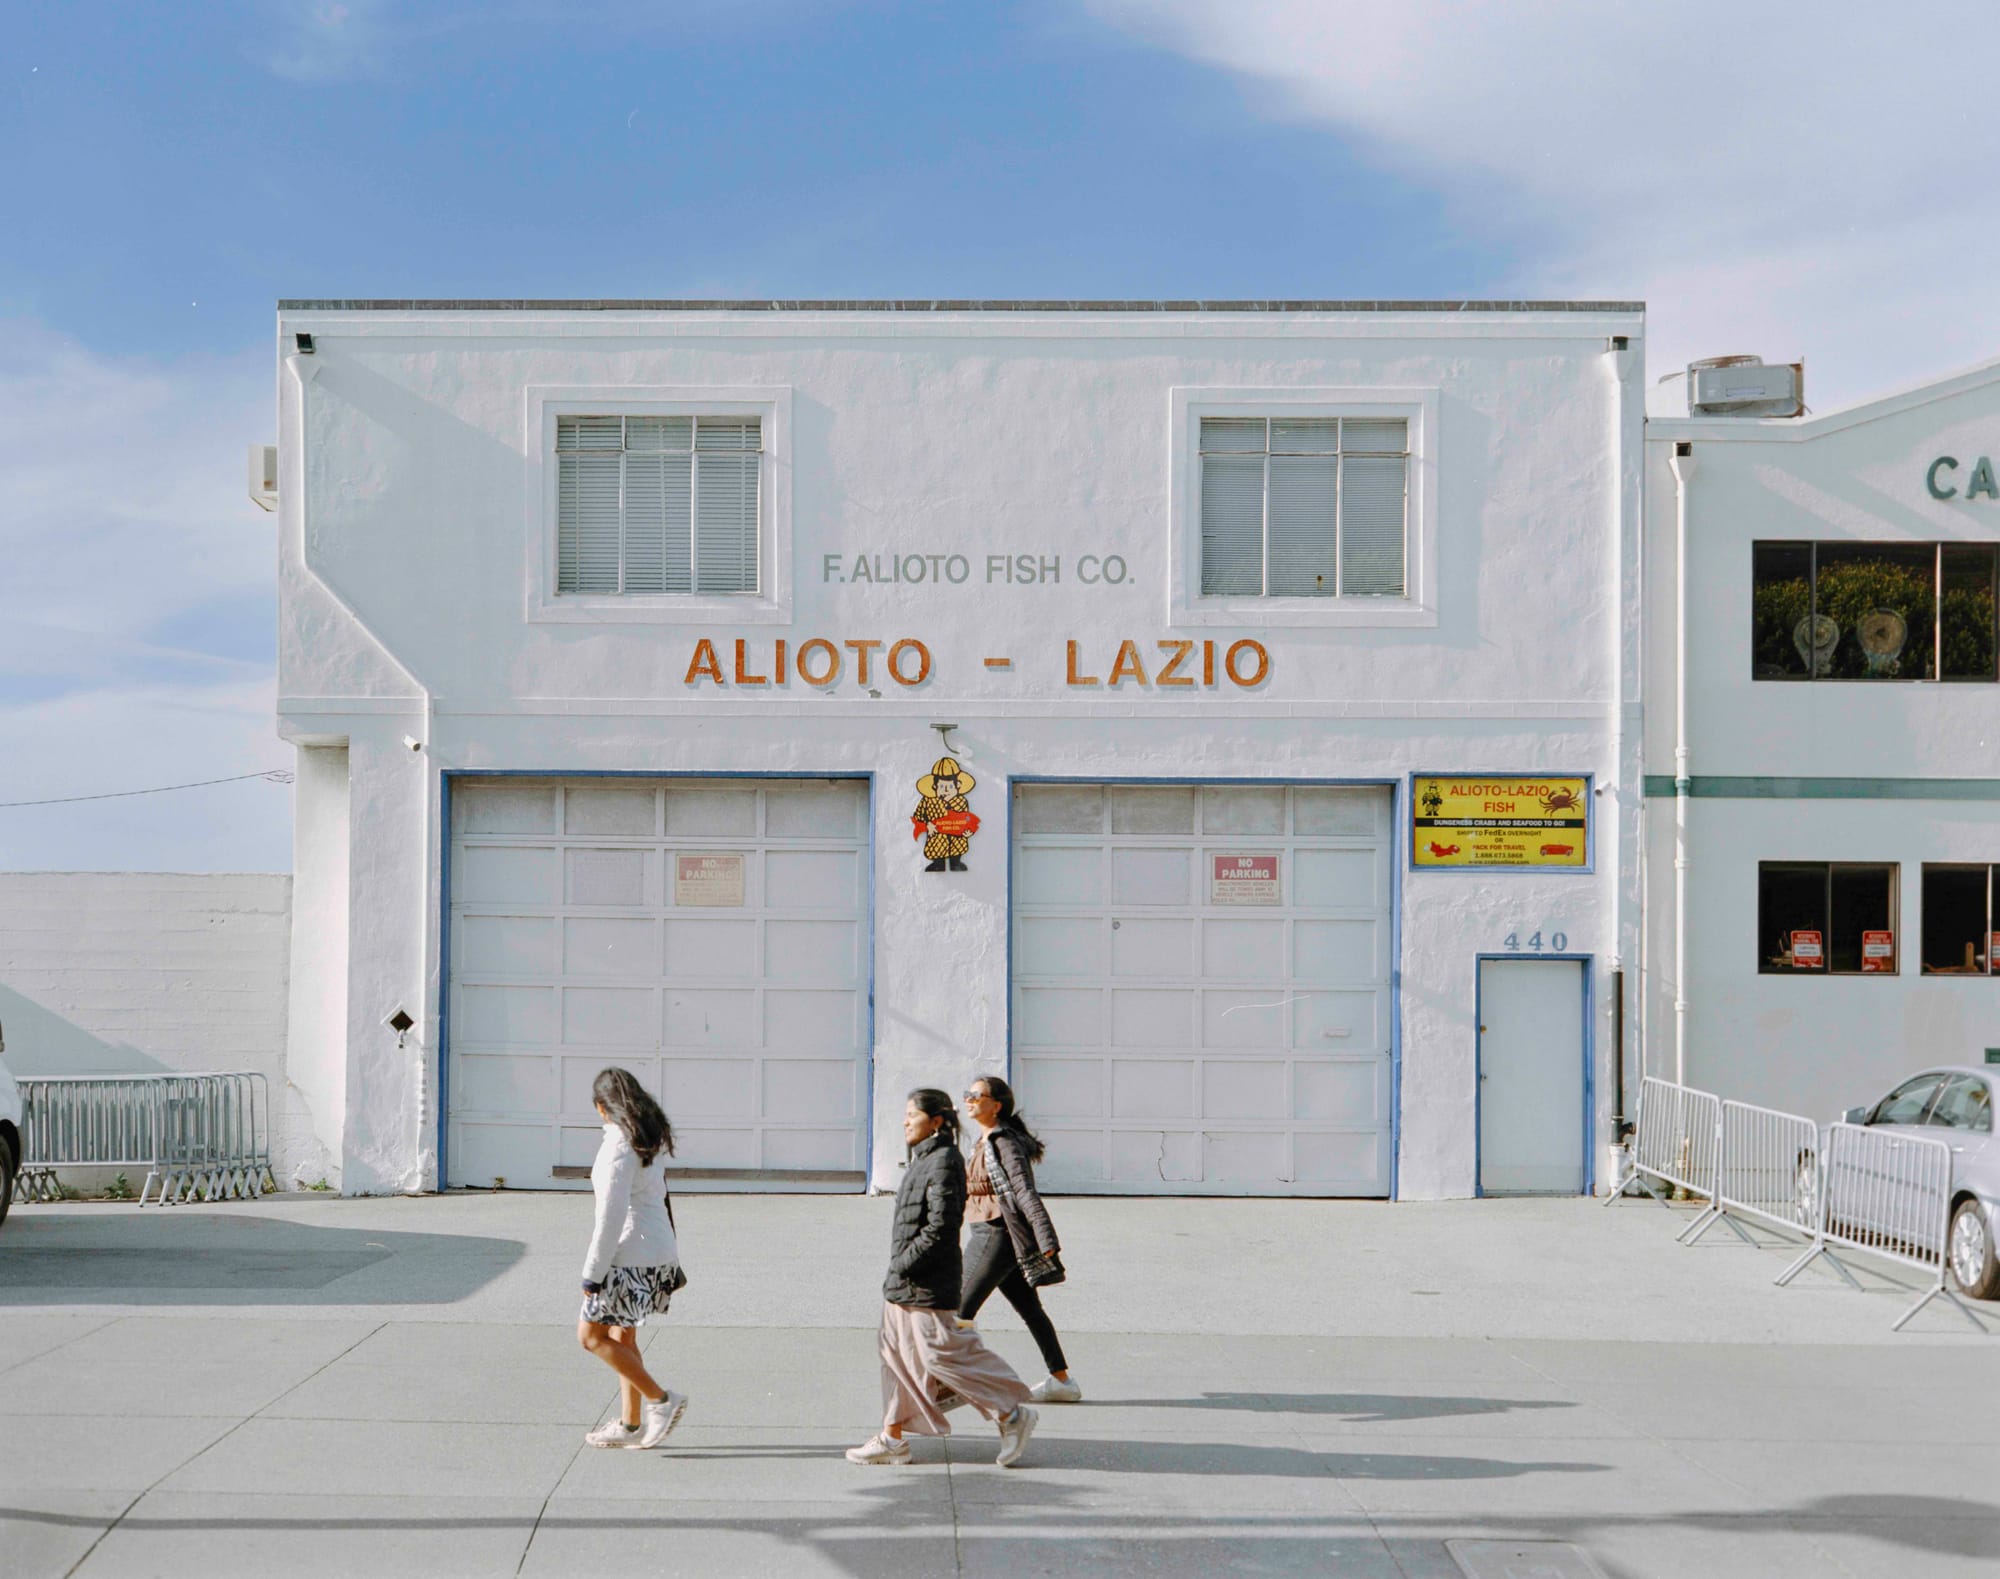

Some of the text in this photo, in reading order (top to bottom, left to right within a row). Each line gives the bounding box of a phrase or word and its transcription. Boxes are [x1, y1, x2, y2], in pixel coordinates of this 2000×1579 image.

[986, 555, 1060, 584] FISH
[1076, 554, 1135, 585] CO.
[684, 638, 933, 687] ALIOTO
[1066, 639, 1269, 687] LAZIO
[1450, 785, 1549, 797] ALIOTO-LAZIO
[1484, 802, 1515, 813] FISH
[1484, 829, 1506, 837] FedEx
[703, 859, 716, 868] NO
[1238, 858, 1253, 868] NO
[686, 870, 736, 879] PARKING
[1222, 869, 1269, 879] PARKING
[1503, 931, 1568, 952] 440
